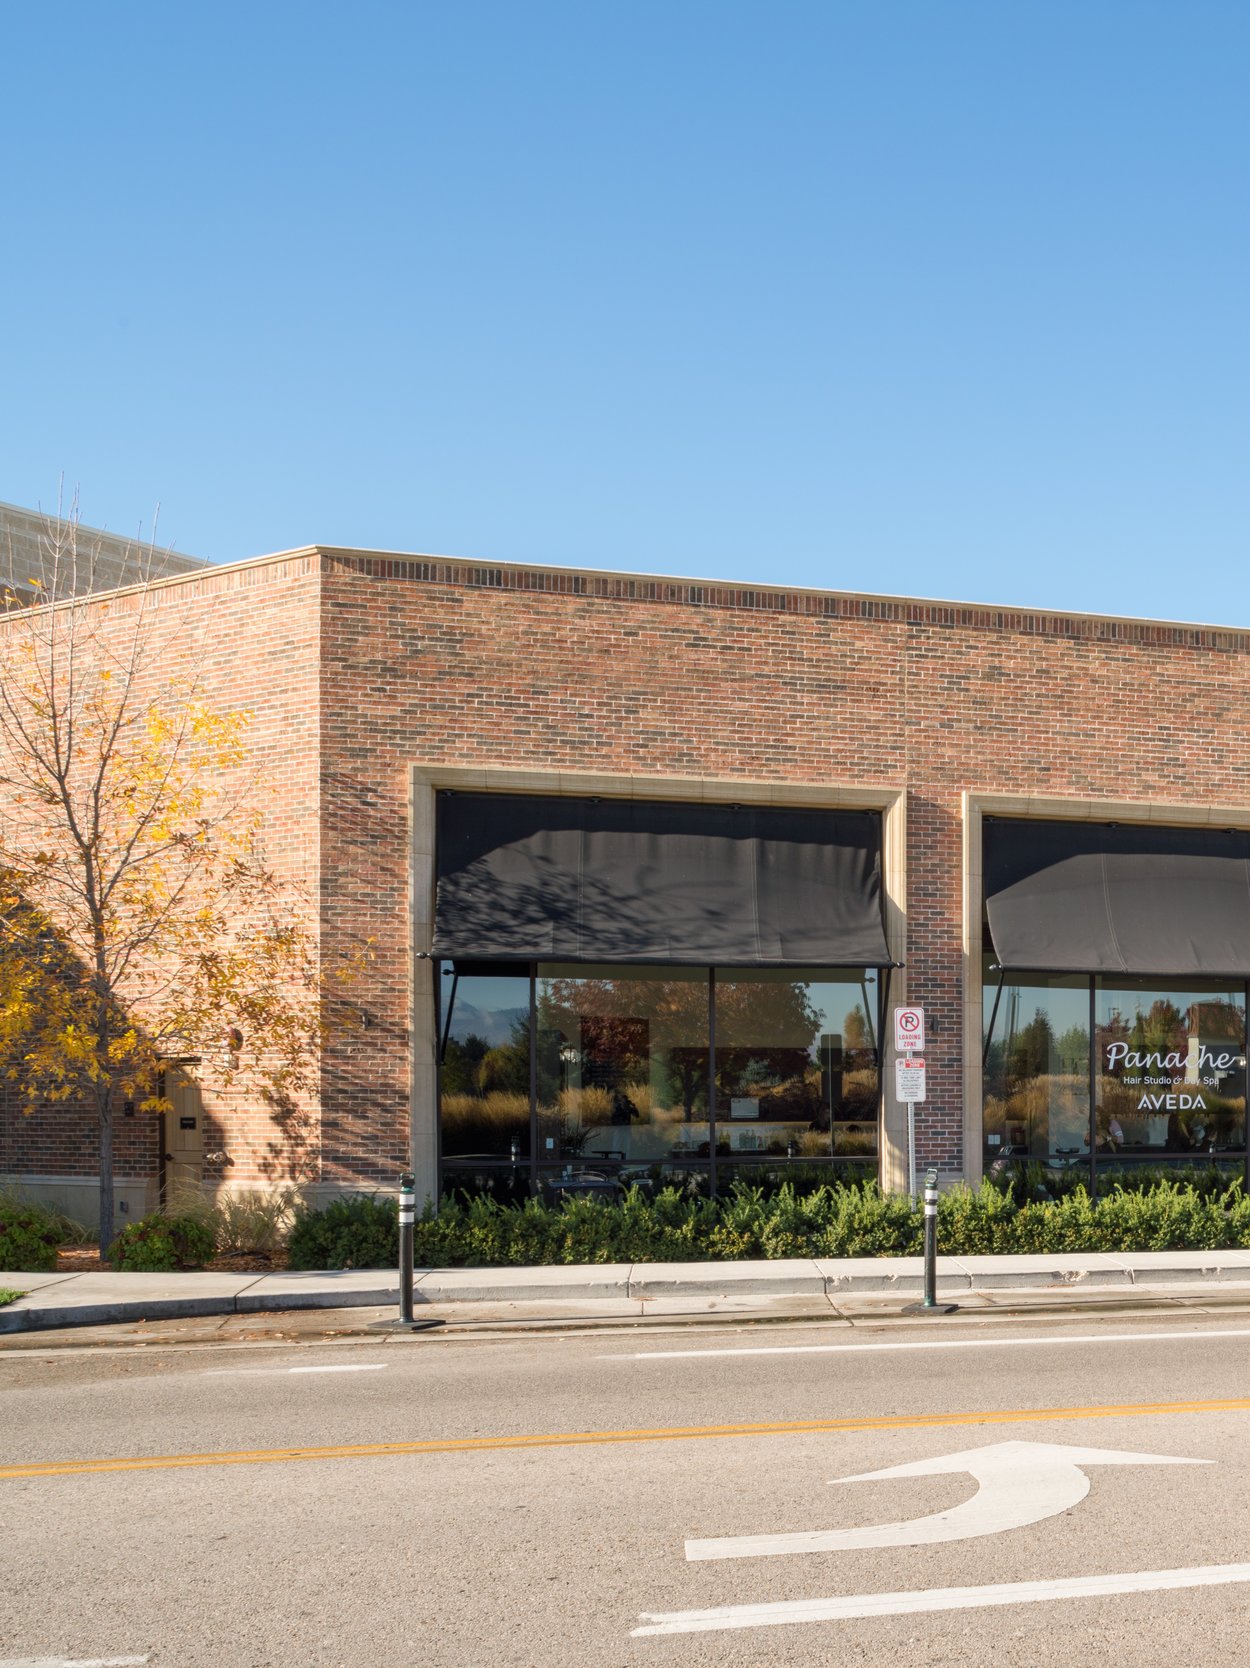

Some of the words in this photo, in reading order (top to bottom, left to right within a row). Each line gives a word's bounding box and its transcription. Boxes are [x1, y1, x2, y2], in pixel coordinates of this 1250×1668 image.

[1107, 1042, 1236, 1070] Panache
[1123, 1076, 1142, 1085] Hair
[1143, 1076, 1172, 1085] Studio
[1173, 1075, 1182, 1085] &
[1184, 1076, 1201, 1086] Day
[1203, 1076, 1219, 1086] Spa
[1137, 1094, 1207, 1110] AVEDA
